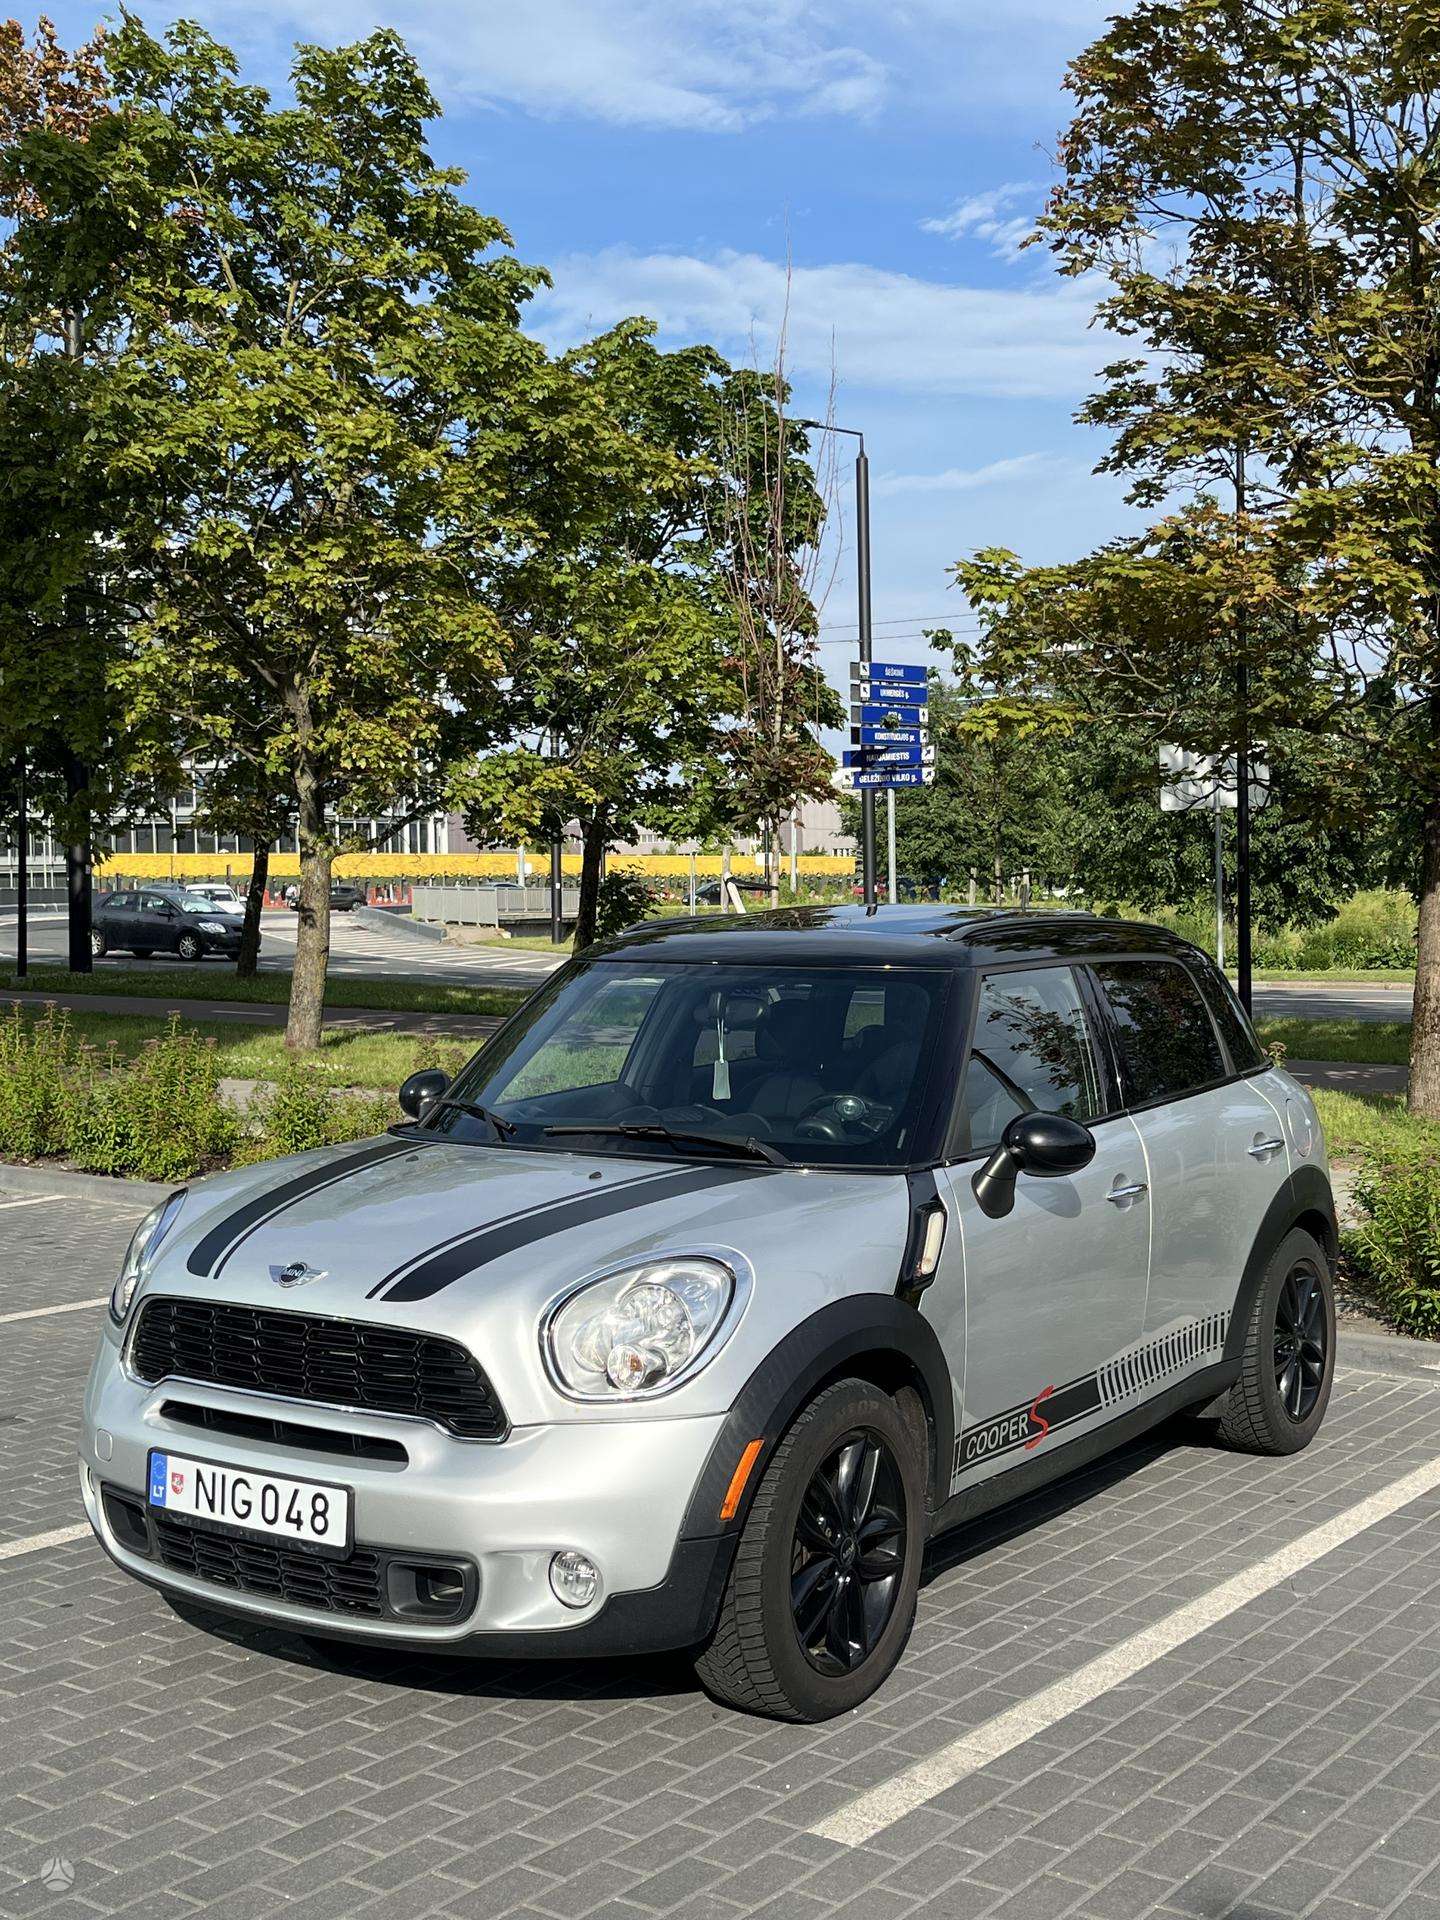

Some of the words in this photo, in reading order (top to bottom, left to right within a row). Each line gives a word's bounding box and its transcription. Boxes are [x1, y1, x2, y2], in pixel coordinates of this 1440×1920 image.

[891, 773, 910, 782] VILKO
[281, 1269, 304, 1277] MINI
[966, 1413, 1029, 1460] COOPER
[1025, 1384, 1055, 1450] S
[152, 1485, 165, 1498] LT
